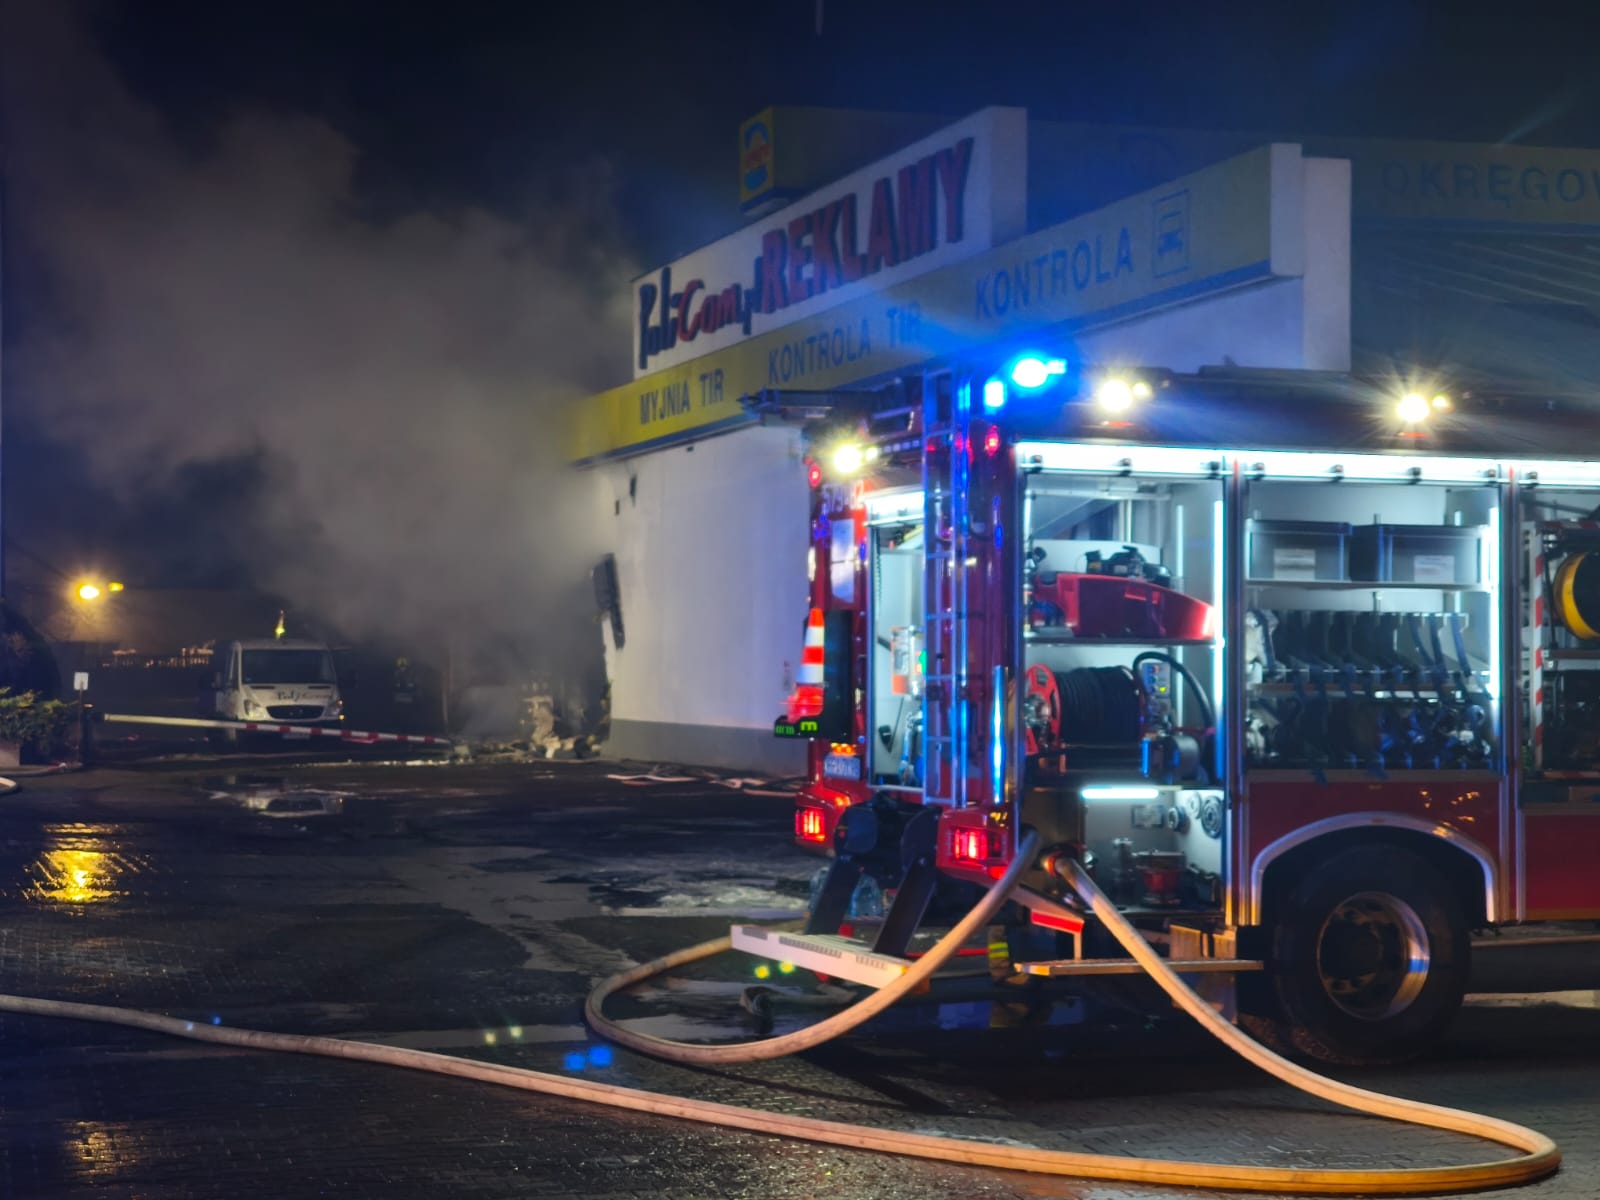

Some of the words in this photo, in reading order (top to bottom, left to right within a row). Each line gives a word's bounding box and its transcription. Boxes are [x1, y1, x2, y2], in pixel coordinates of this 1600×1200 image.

[762, 137, 975, 314] REKLAMY
[1381, 161, 1600, 208] OKRĘGO
[975, 227, 1134, 322] KONTROLA
[768, 318, 872, 385] KONTROLA
[886, 301, 921, 348] TIR
[640, 378, 691, 425] MYJNIA
[699, 368, 725, 407] TIR
